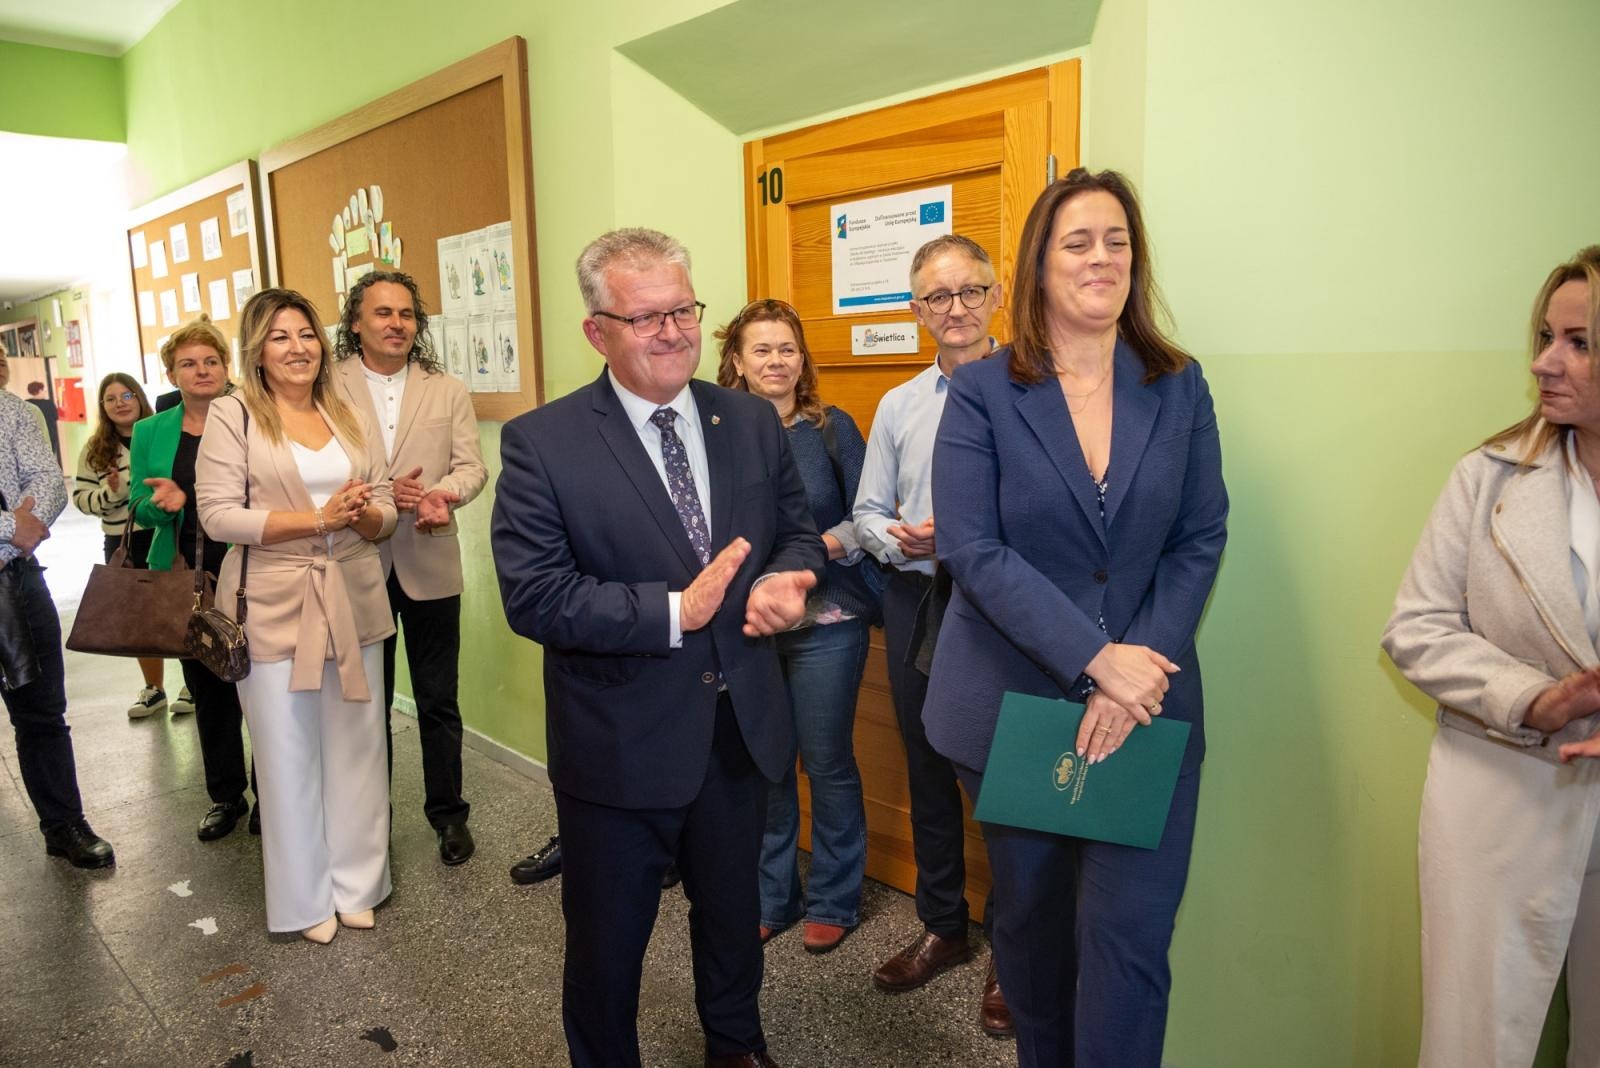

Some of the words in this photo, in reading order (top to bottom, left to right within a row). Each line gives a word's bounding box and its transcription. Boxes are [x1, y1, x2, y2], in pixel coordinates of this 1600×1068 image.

[758, 168, 783, 206] 10
[849, 224, 870, 232] Europejskie
[873, 330, 905, 343] Świetlica
